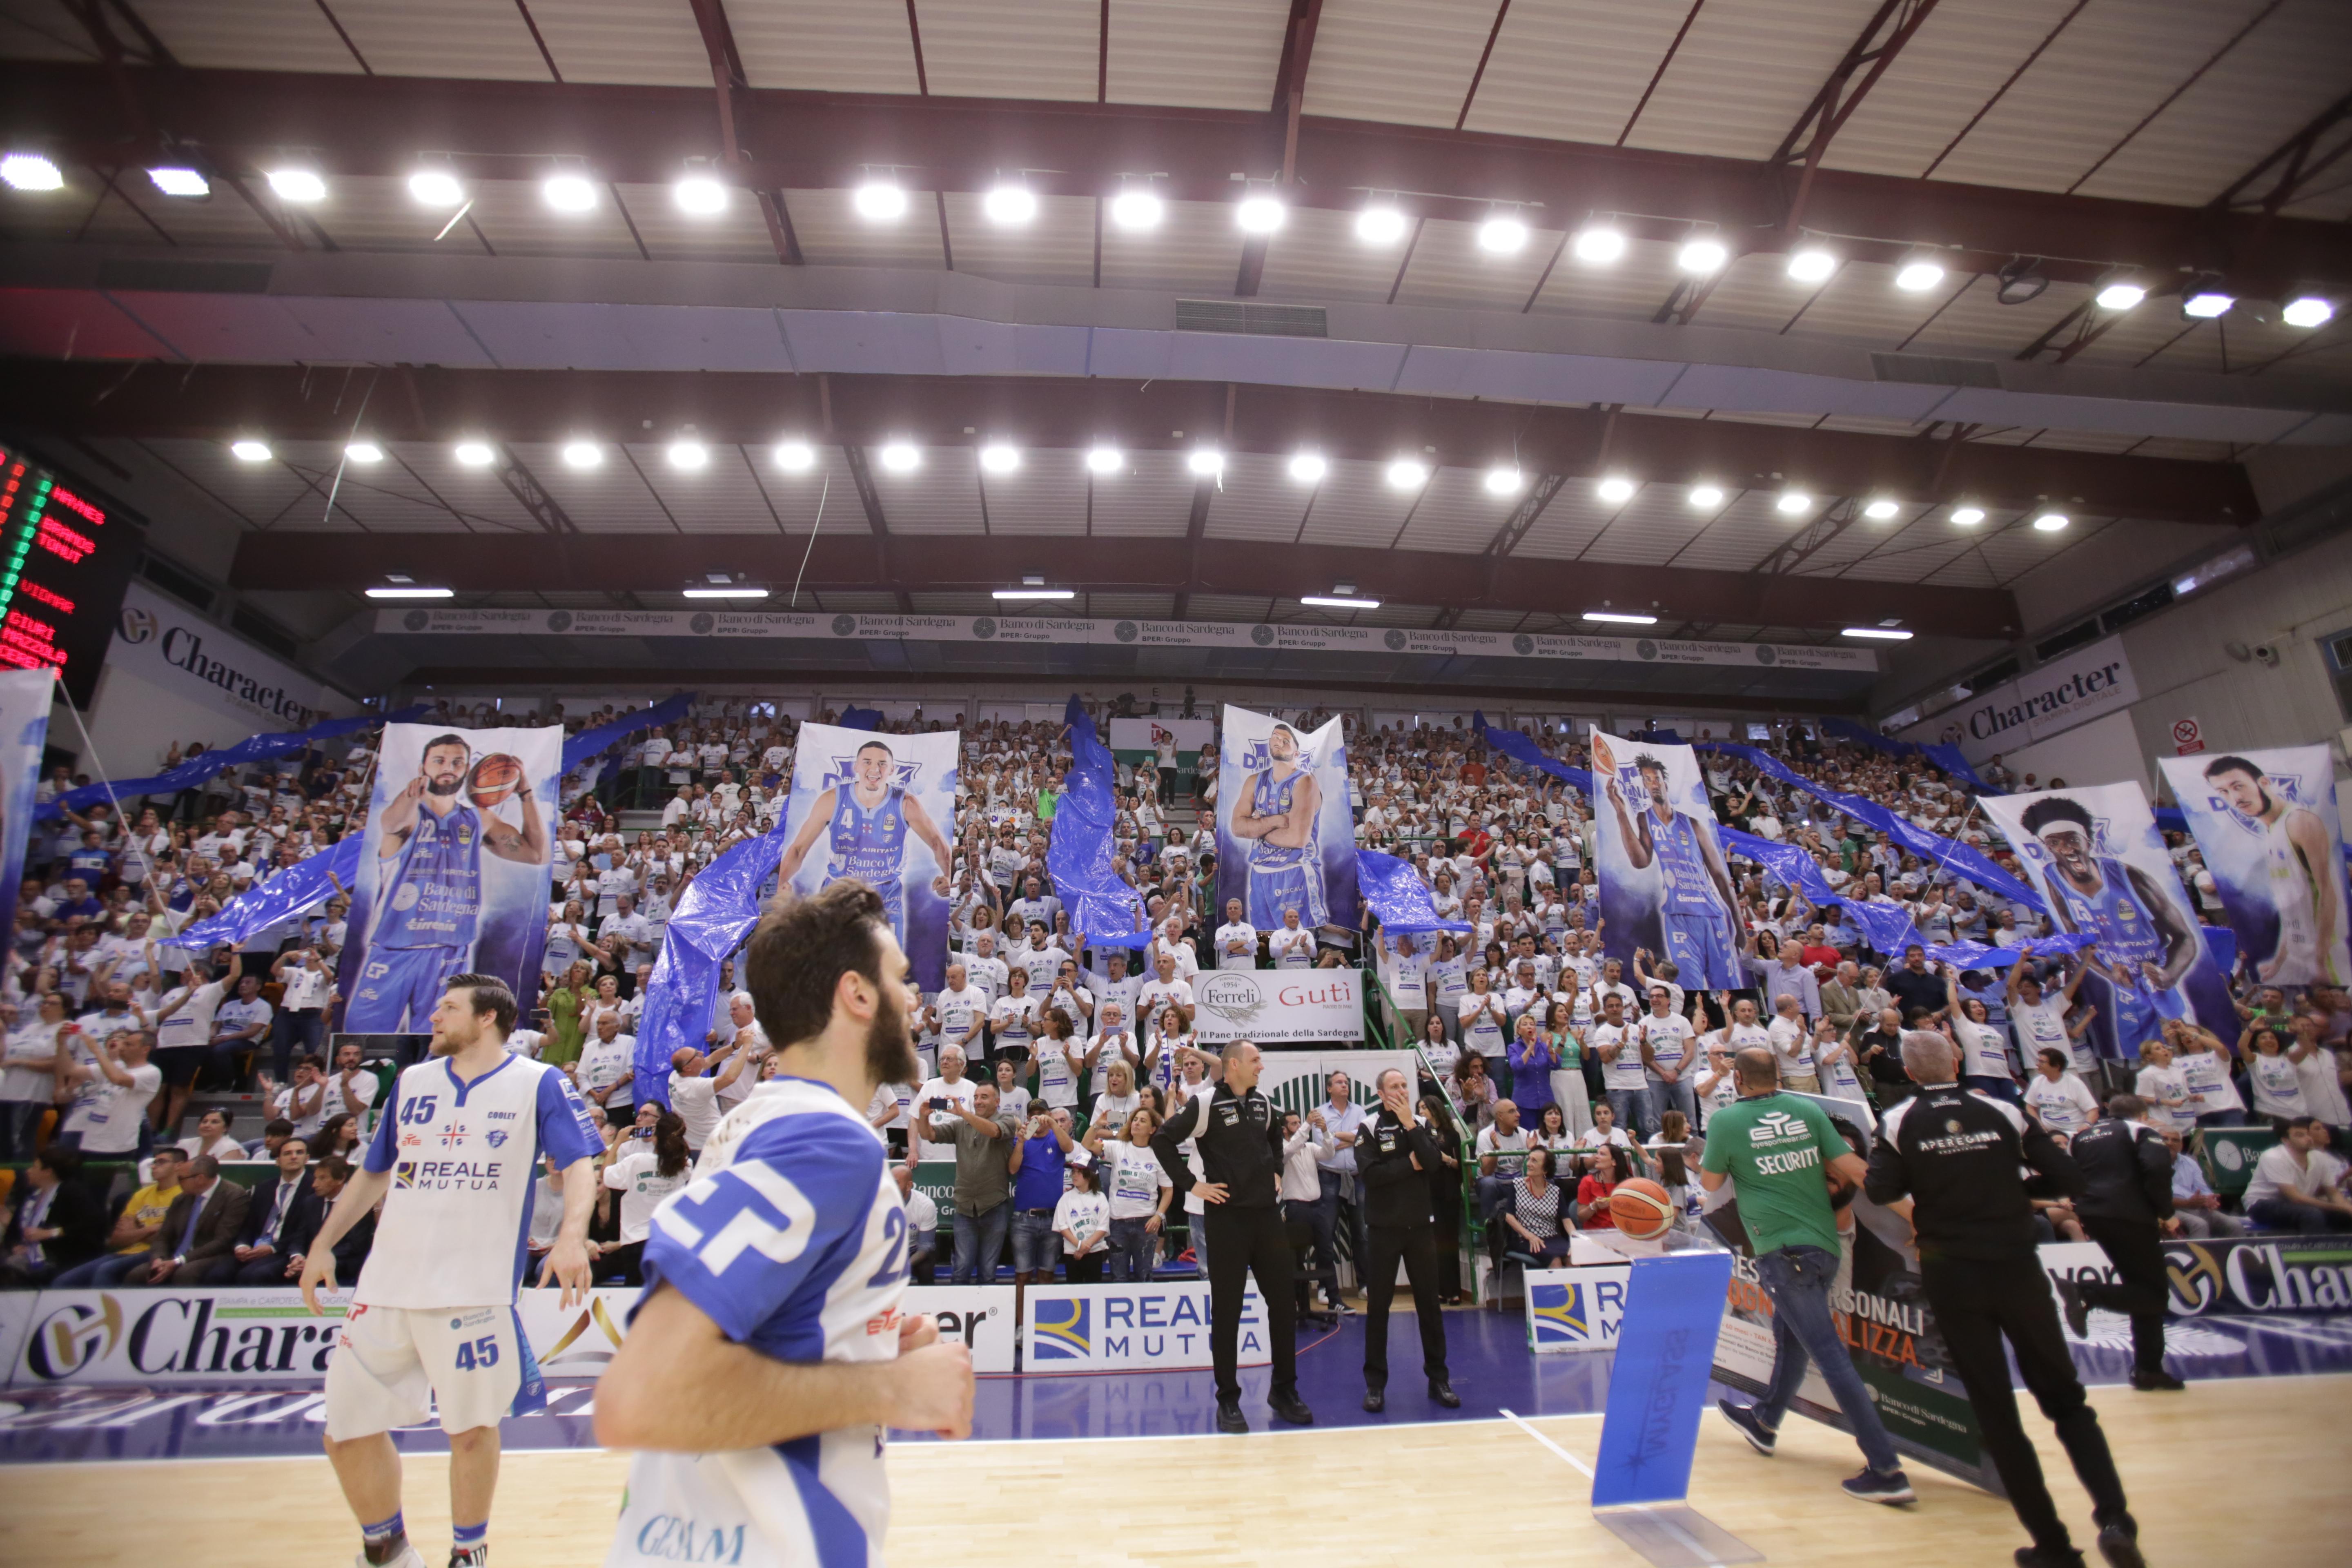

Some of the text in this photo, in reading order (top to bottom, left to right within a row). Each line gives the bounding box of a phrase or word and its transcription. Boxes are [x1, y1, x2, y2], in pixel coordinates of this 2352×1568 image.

[576, 612, 673, 624] Banco di Sardegna
[718, 614, 814, 626] Banco di Sardegna
[860, 616, 955, 628] Banco di Sardegna
[1000, 619, 1095, 632] Banco di Sardegna
[1142, 623, 1234, 635] Banco di Sardegna
[1278, 626, 1368, 639] Banco di Sardegna
[1409, 631, 1497, 644] Banco di Sardegna
[1537, 636, 1621, 649] Banco di Sardegna
[1659, 641, 1741, 654] Banco di Sardegna
[162, 626, 313, 728] Character
[1970, 662, 2120, 740] Character
[2032, 684, 2122, 727] STAMPA DIGITALE
[841, 808, 853, 829] 4
[1651, 825, 1667, 842] 21
[849, 856, 884, 868] Banco
[423, 882, 476, 899] Banco di
[1677, 880, 1708, 892] Sardegna
[418, 898, 480, 917] Sardegna
[1208, 989, 1254, 1004] Ferreli
[1279, 982, 1350, 1007] Gutì
[1235, 1029, 1290, 1038] tradizionale
[1318, 1029, 1359, 1038] Sardegna
[399, 1095, 517, 1126] 45 COOLEY
[1931, 1098, 1962, 1109] SPALDING
[1756, 1146, 1820, 1176] SECURITY
[421, 1163, 502, 1178] REALE
[419, 1180, 498, 1191] MUTUA
[218, 1297, 248, 1305] STAMPA
[463, 1311, 483, 1321] Banco
[1105, 1293, 1260, 1329] REALE
[1829, 1287, 1924, 1337] RSONALI
[463, 1314, 496, 1328] Sardegna
[128, 1298, 342, 1375] Chara
[1735, 1327, 1748, 1336] mesi
[1753, 1332, 1766, 1342] TAN
[1833, 1311, 1926, 1370] ALIZZA.
[1105, 1331, 1261, 1358] MUTA
[455, 1334, 499, 1371] 45
[1881, 1393, 1967, 1434] Banco di Sardegna
[1902, 1413, 1926, 1427] Gruppo
